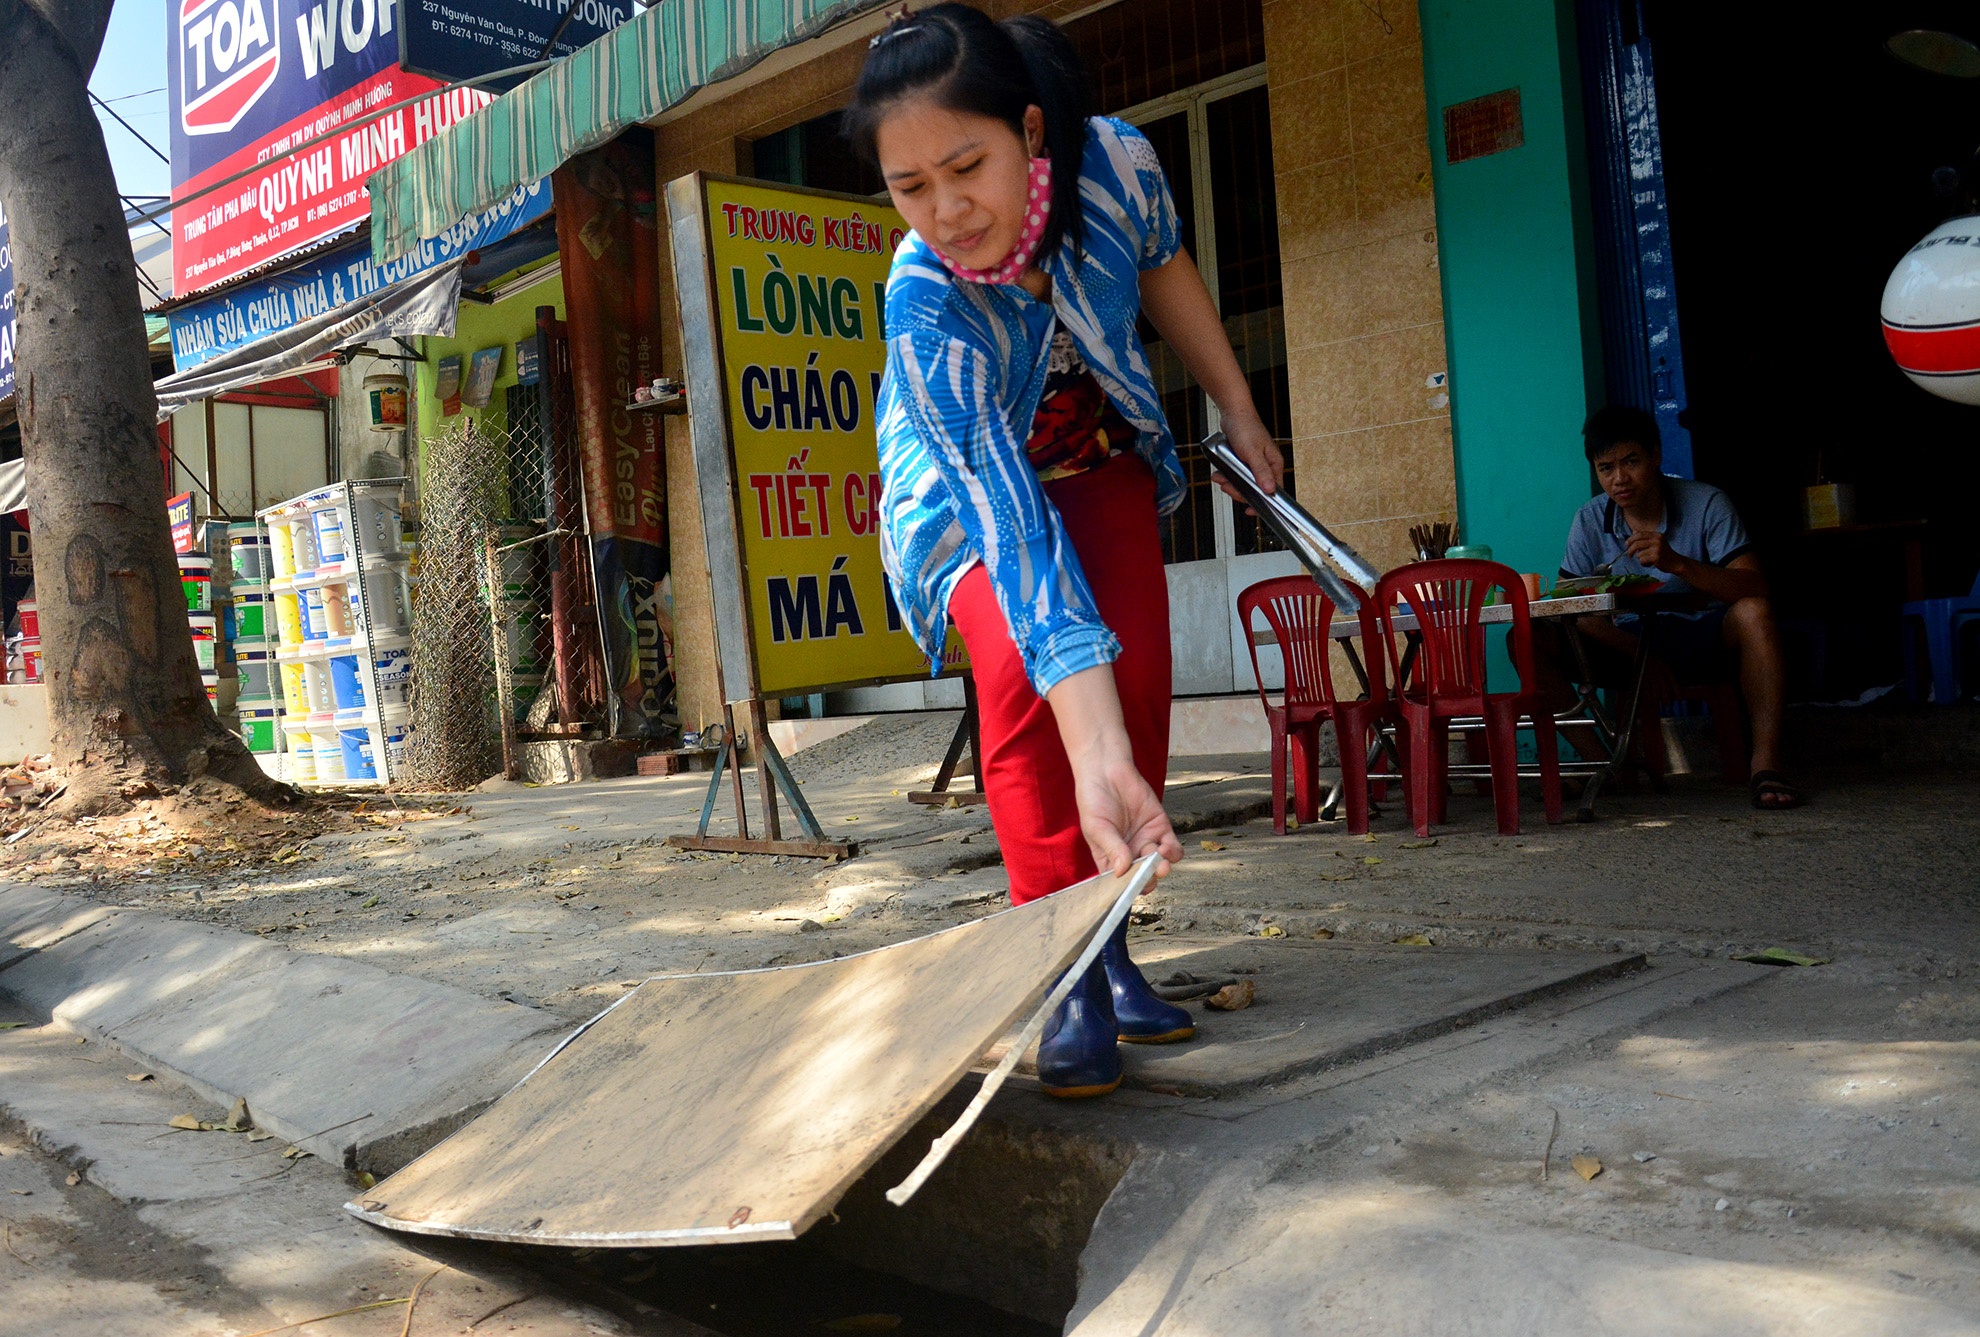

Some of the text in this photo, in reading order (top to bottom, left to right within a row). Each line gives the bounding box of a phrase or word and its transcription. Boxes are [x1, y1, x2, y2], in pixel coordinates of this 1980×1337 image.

[188, 0, 270, 90] TOA
[422, 1, 438, 13] 237
[432, 20, 448, 34] ĐT:
[450, 25, 472, 40] 6274
[473, 32, 494, 46] 1707
[500, 40, 521, 54] 3536
[257, 81, 393, 163] CTY TNHH TM DV QUỲNH MINH HƯƠNG
[184, 216, 207, 243] TRUNG
[206, 205, 223, 230] TÂM
[224, 202, 239, 223] PHA
[240, 186, 257, 215] MÀU
[258, 146, 333, 224] QUỲNH
[340, 110, 405, 182] MINH
[342, 190, 357, 208] 1707
[722, 203, 815, 247] TRUNG
[823, 212, 883, 255] KIÊN
[175, 312, 217, 357] NHẬN
[217, 299, 246, 345] SỬA
[248, 284, 290, 332] CHỮA
[292, 269, 325, 320] NHÀ
[332, 272, 346, 302] &
[731, 253, 863, 341] LÒNG
[611, 329, 640, 527] EasyClean
[741, 351, 860, 433] CHÁO
[643, 428, 656, 453] Lau
[750, 448, 830, 539] TIẾT
[767, 555, 864, 643] MÁ
[383, 649, 407, 659] TOA
